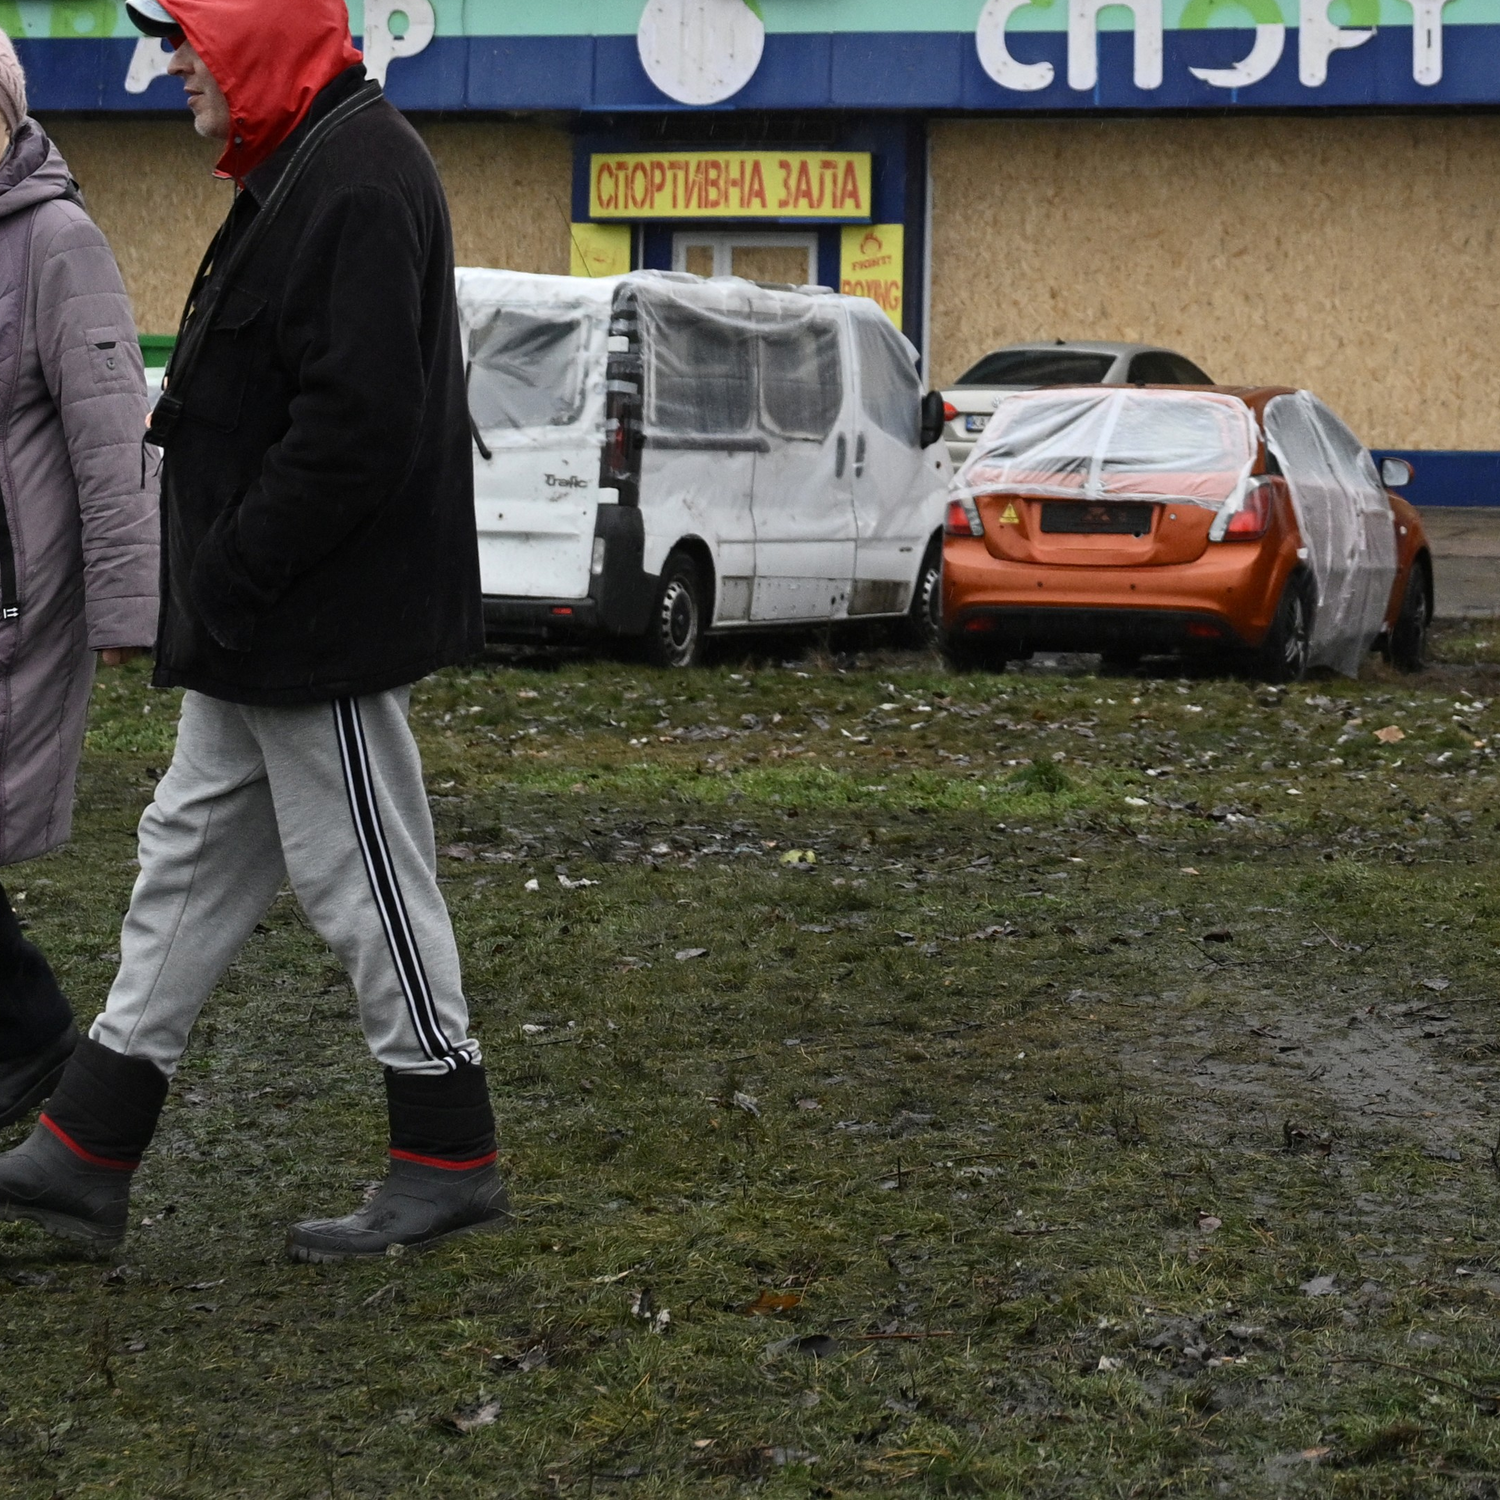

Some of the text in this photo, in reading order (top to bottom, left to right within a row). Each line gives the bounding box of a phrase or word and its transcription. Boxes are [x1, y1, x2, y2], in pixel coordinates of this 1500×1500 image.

[597, 158, 862, 210] СПОРТИВНА ЗАЛА
[544, 473, 589, 489] Trafic
